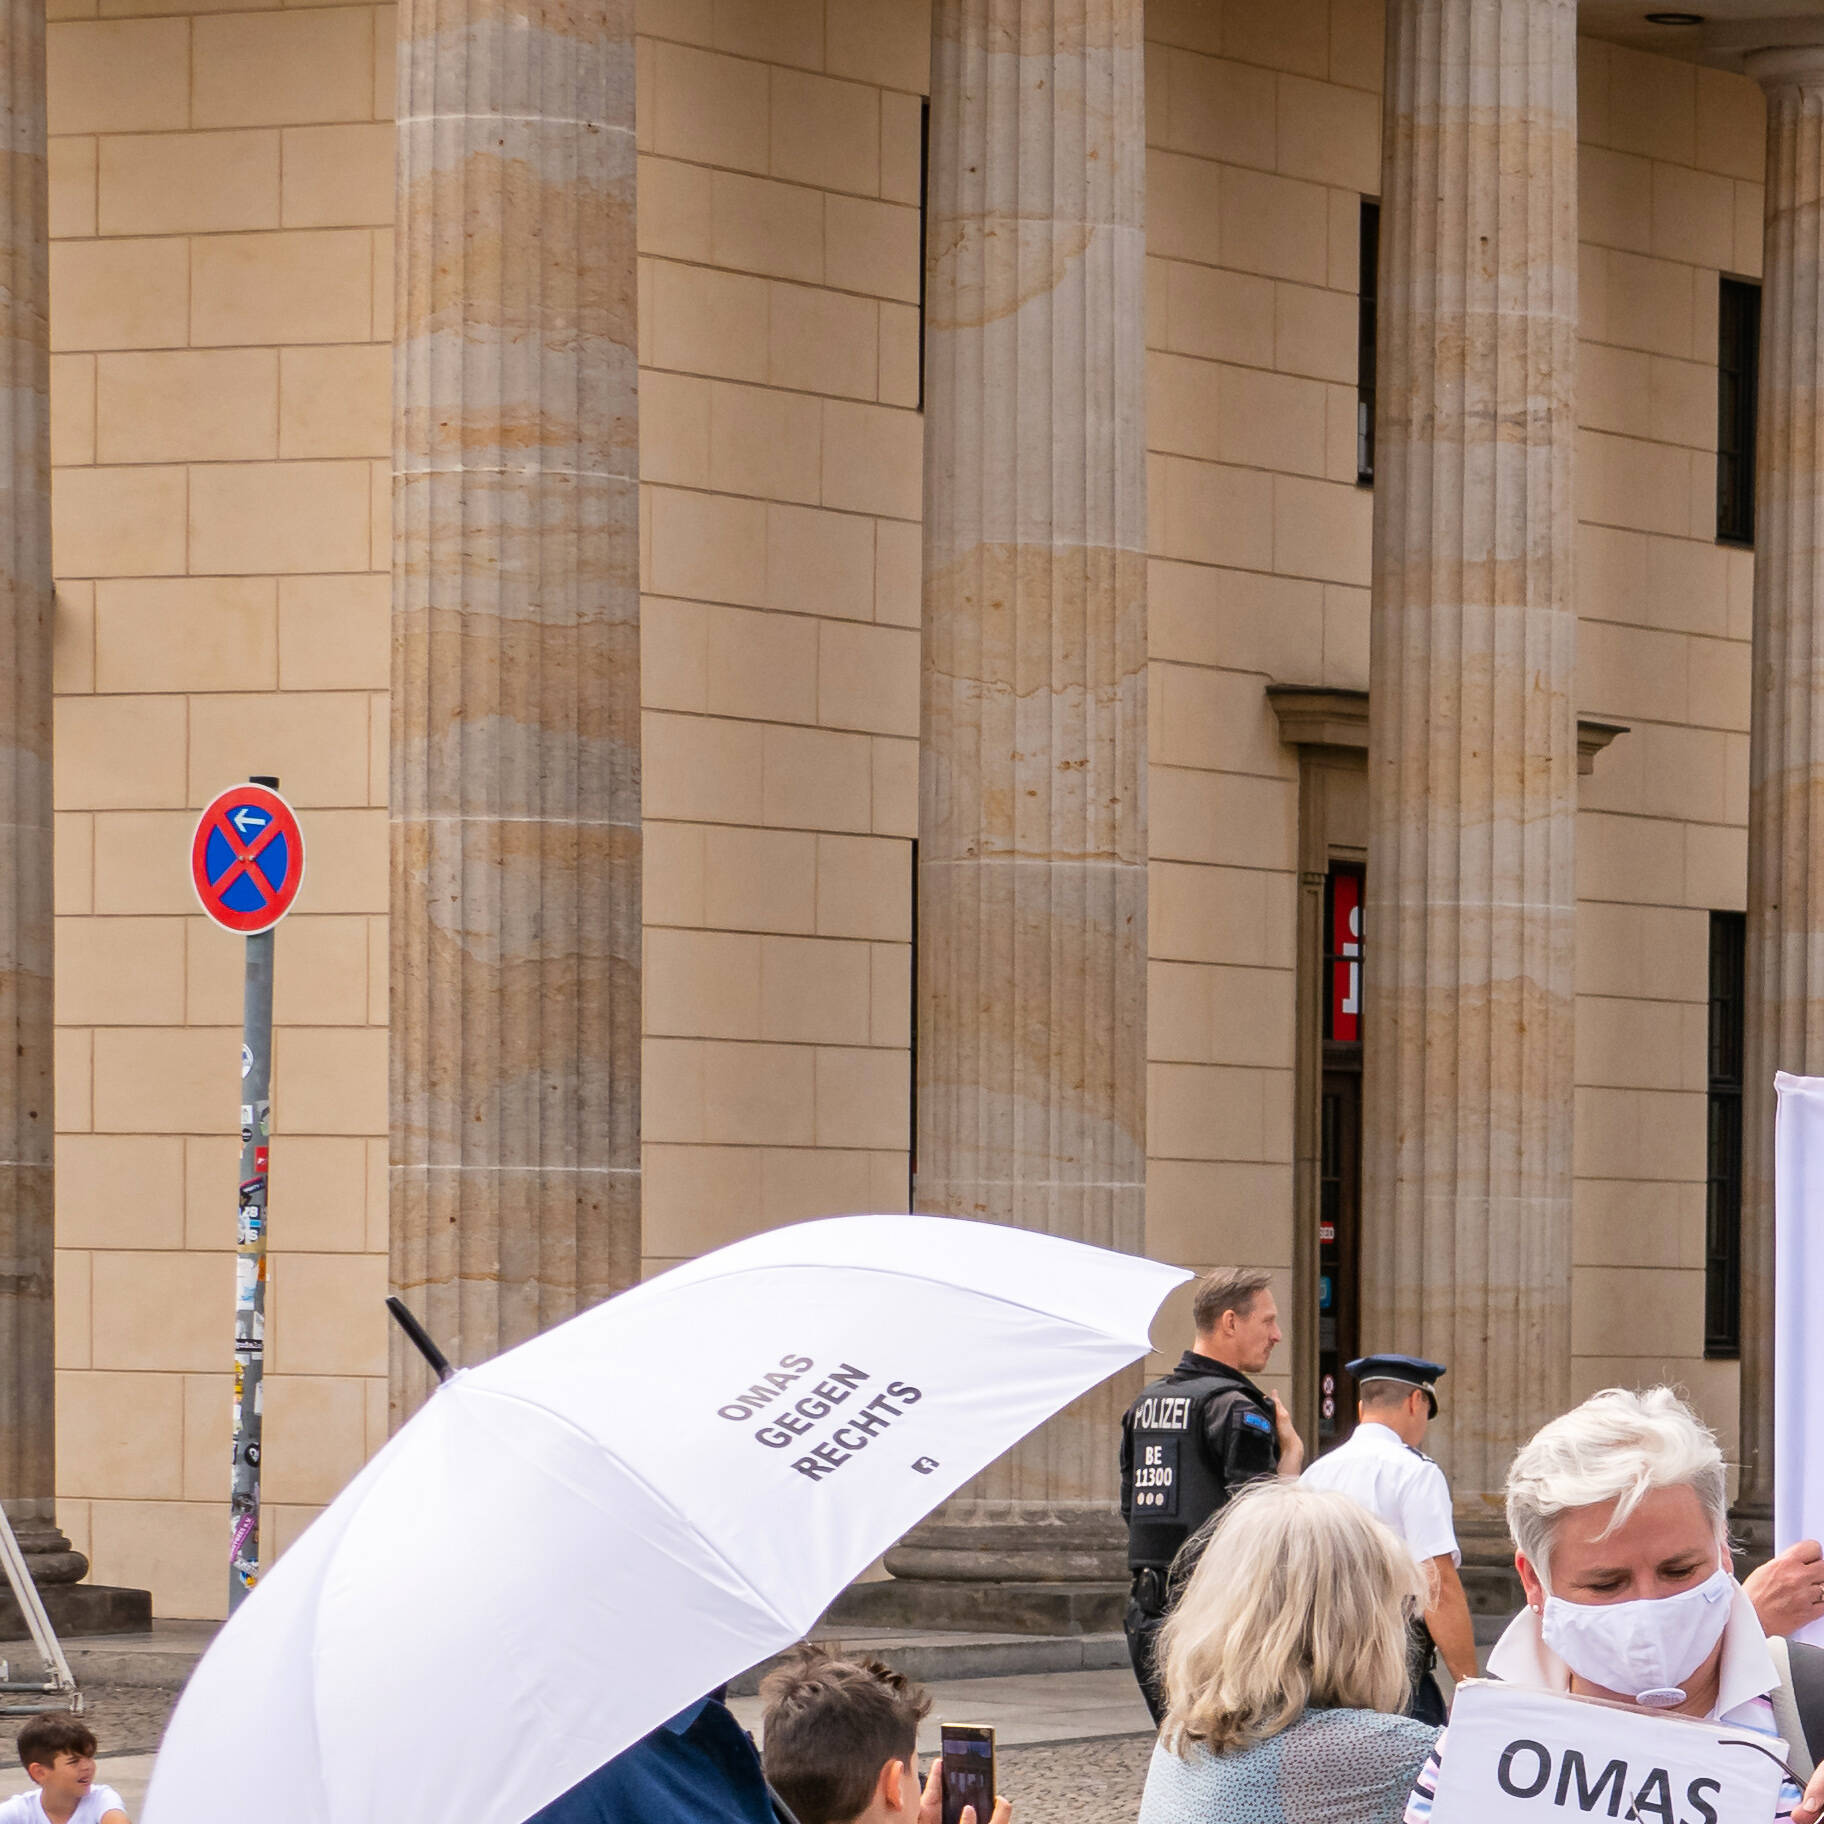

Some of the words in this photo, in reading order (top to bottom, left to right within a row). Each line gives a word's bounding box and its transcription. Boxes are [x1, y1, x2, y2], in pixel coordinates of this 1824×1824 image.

[716, 1353, 814, 1421] OMAS
[754, 1363, 870, 1449] GEGEN
[1134, 1397, 1191, 1430] POLIZEI
[790, 1380, 922, 1482] RECHTS
[1144, 1446, 1163, 1466] BE
